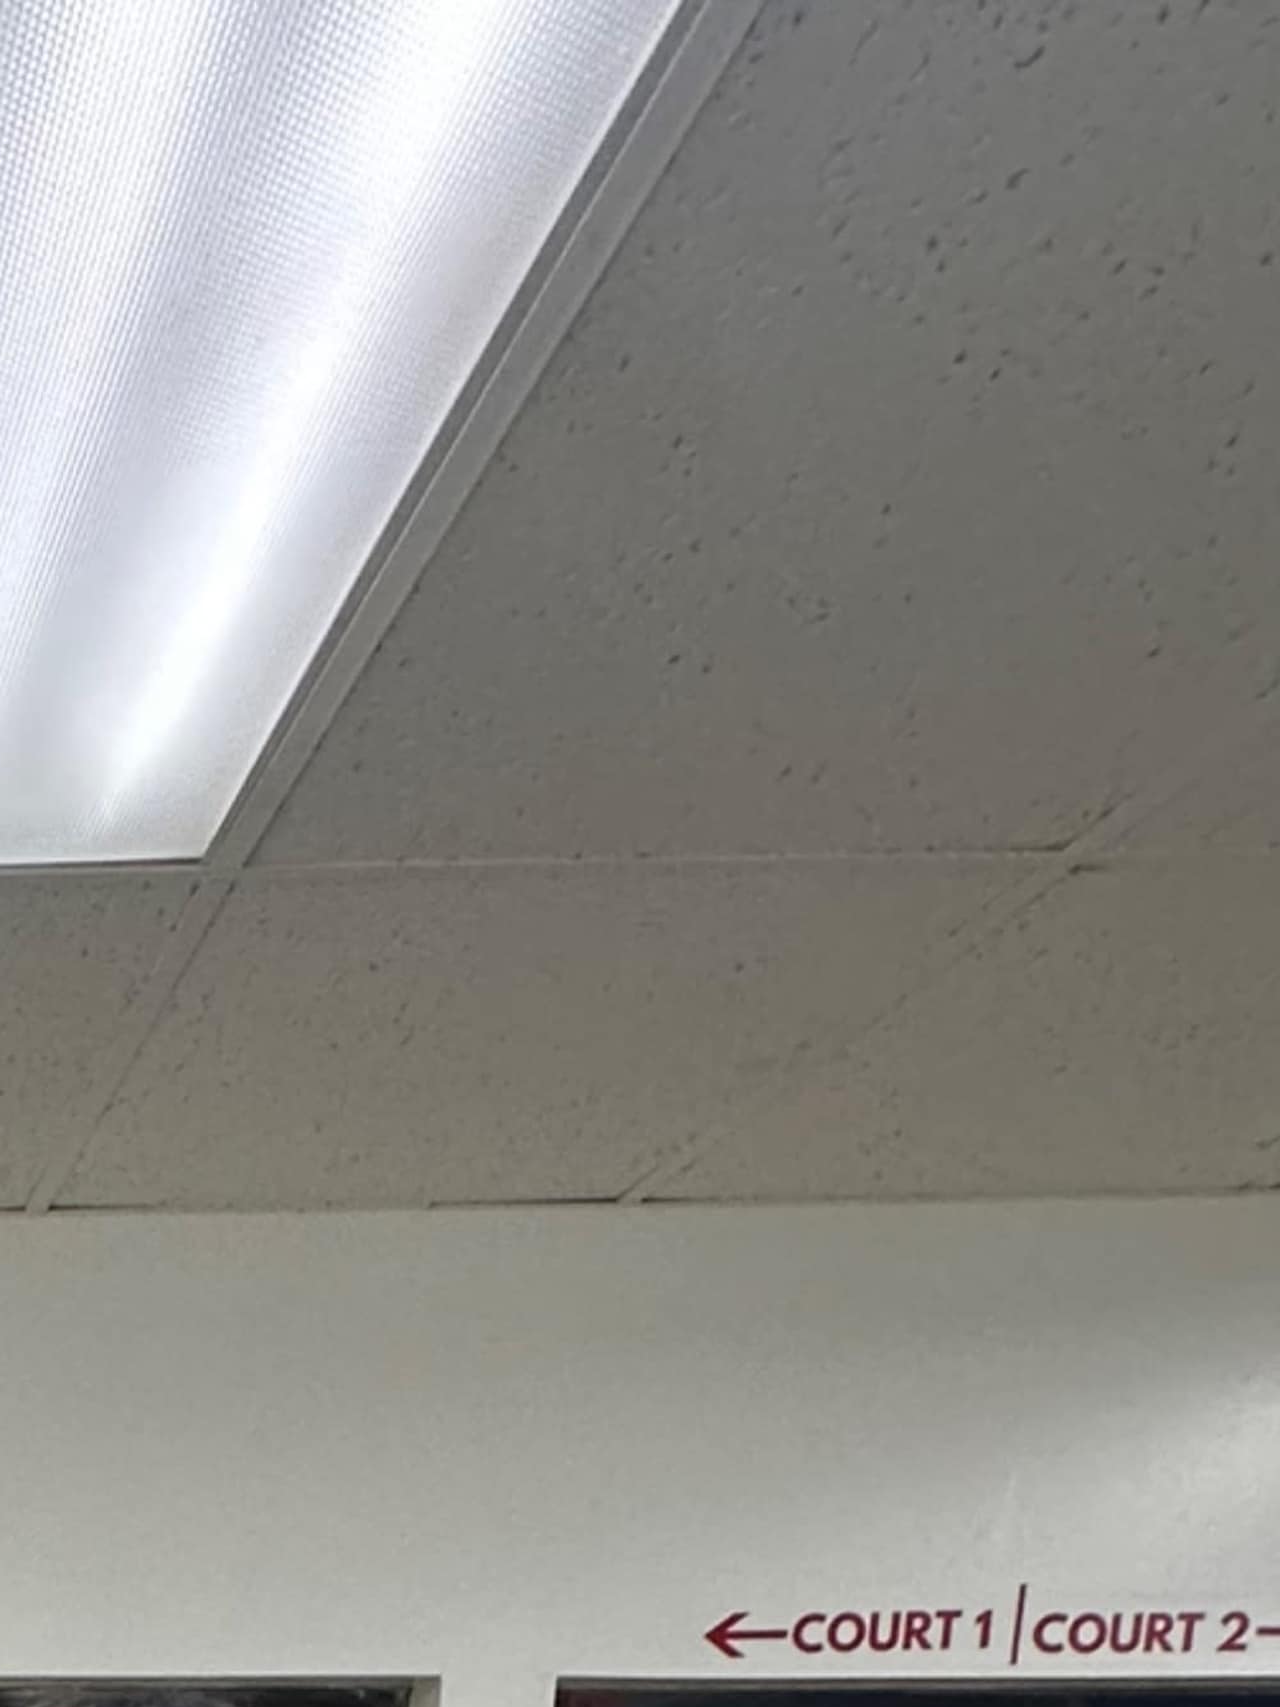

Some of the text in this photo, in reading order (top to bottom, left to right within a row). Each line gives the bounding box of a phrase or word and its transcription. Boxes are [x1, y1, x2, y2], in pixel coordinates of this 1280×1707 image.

[792, 1610, 994, 1653] COURT 1
[1032, 1612, 1251, 1654] COURT 2
